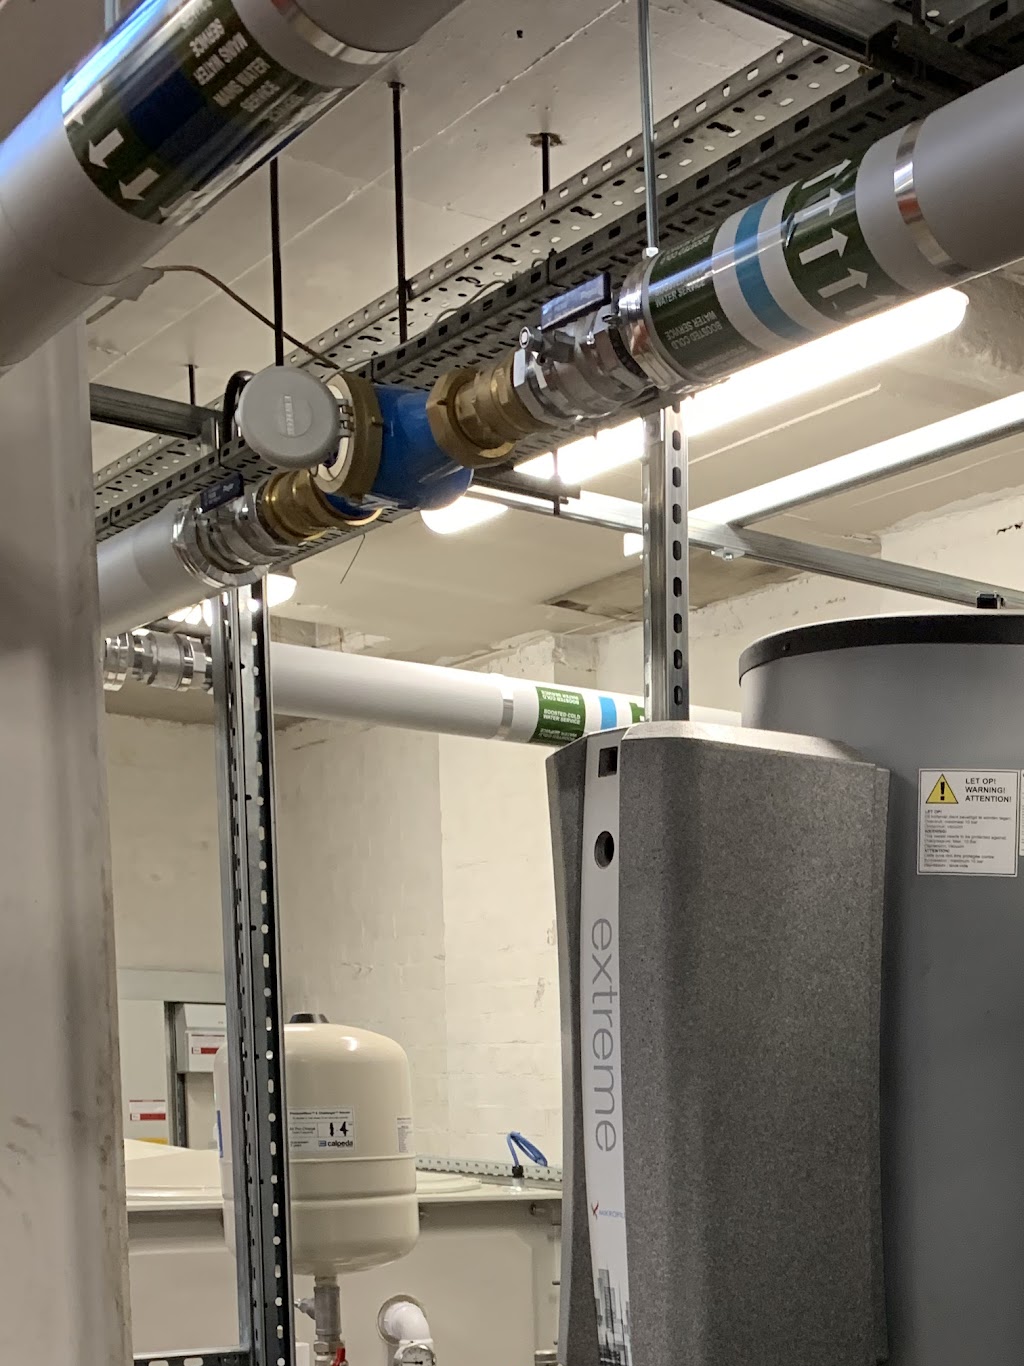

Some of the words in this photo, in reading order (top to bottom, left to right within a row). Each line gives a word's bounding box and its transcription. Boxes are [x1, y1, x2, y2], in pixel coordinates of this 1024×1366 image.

[965, 786, 1005, 794] WARNING!
[965, 795, 1012, 803] ATTENTION!
[591, 918, 617, 1152] extreme
